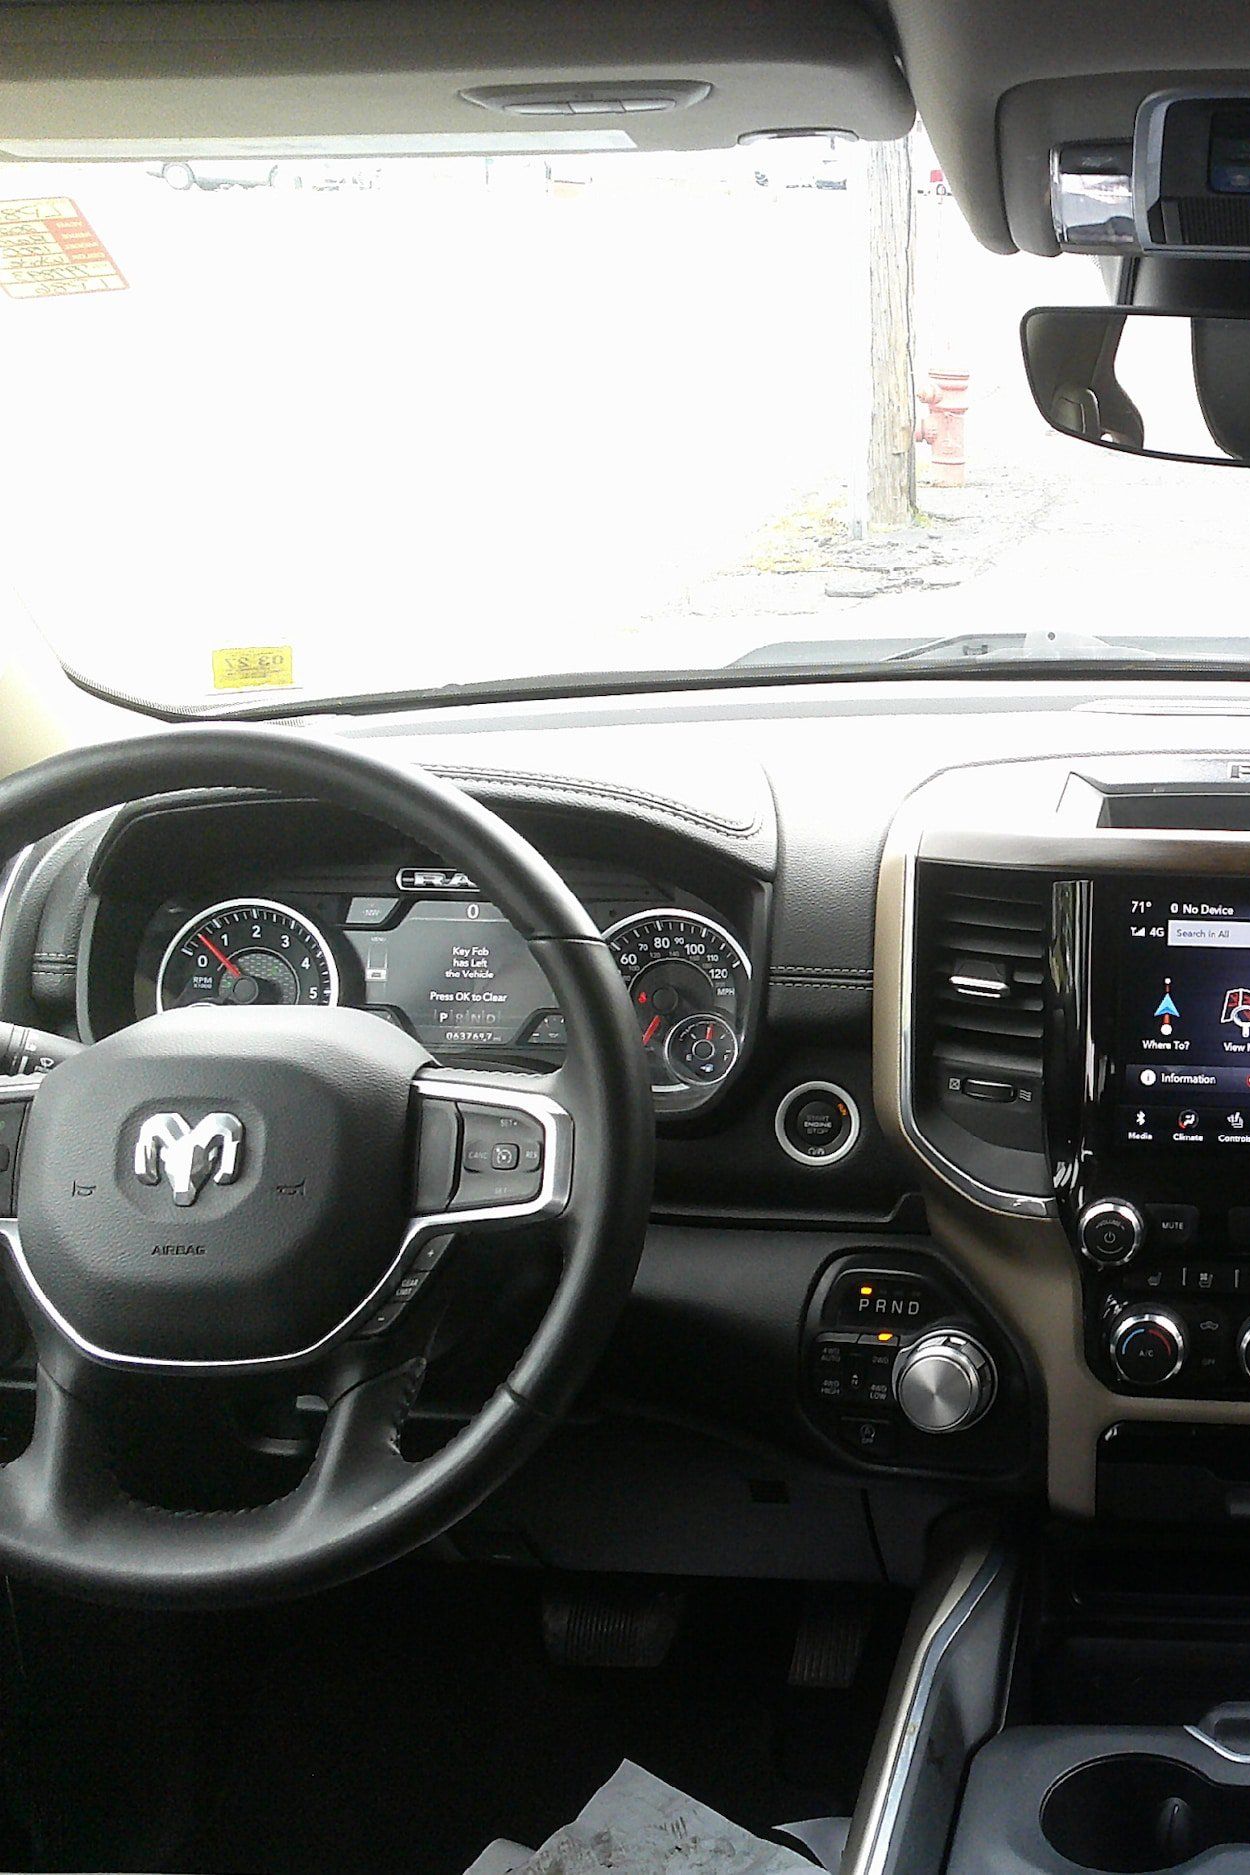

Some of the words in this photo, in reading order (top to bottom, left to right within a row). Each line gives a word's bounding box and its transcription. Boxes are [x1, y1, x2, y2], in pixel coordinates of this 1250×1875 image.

[414, 872, 480, 888] RA
[467, 904, 480, 919] 0
[1183, 904, 1198, 914] No
[1201, 904, 1234, 915] Device
[252, 925, 262, 938] 2
[1149, 927, 1165, 937] 4G
[1176, 929, 1206, 938] Search
[1208, 930, 1216, 938] in
[1218, 930, 1230, 938] All
[221, 934, 228, 946] 1
[281, 935, 290, 948] 3
[654, 937, 670, 949] 80
[674, 937, 684, 945] 90
[452, 947, 470, 957] Key
[472, 947, 489, 956] Fob
[638, 943, 649, 951] 70
[685, 944, 705, 955] 100
[197, 955, 208, 968] 0
[301, 957, 310, 969] 4
[453, 958, 469, 967] has
[471, 958, 488, 968] Left
[620, 953, 638, 965] 60
[707, 954, 719, 962] 110
[445, 969, 460, 978] the
[462, 969, 494, 978] Vehicle
[709, 968, 728, 979] 120
[193, 976, 213, 984] RPM
[309, 987, 318, 999] 5
[430, 991, 454, 1001] Press
[455, 992, 471, 1001] OK
[472, 993, 482, 1002] to
[482, 992, 508, 1002] Clear
[717, 988, 735, 997] MPH
[439, 1012, 448, 1023] P
[1142, 1040, 1172, 1050] Where
[1173, 1040, 1190, 1051] To?
[1223, 1042, 1245, 1052] View
[1161, 1073, 1217, 1084] Information
[1128, 1132, 1153, 1140] Media
[1172, 1133, 1204, 1142] Climate
[1161, 1221, 1184, 1230] MUTE
[151, 1245, 206, 1256] AIRBAG
[1138, 1350, 1154, 1358] A/C
